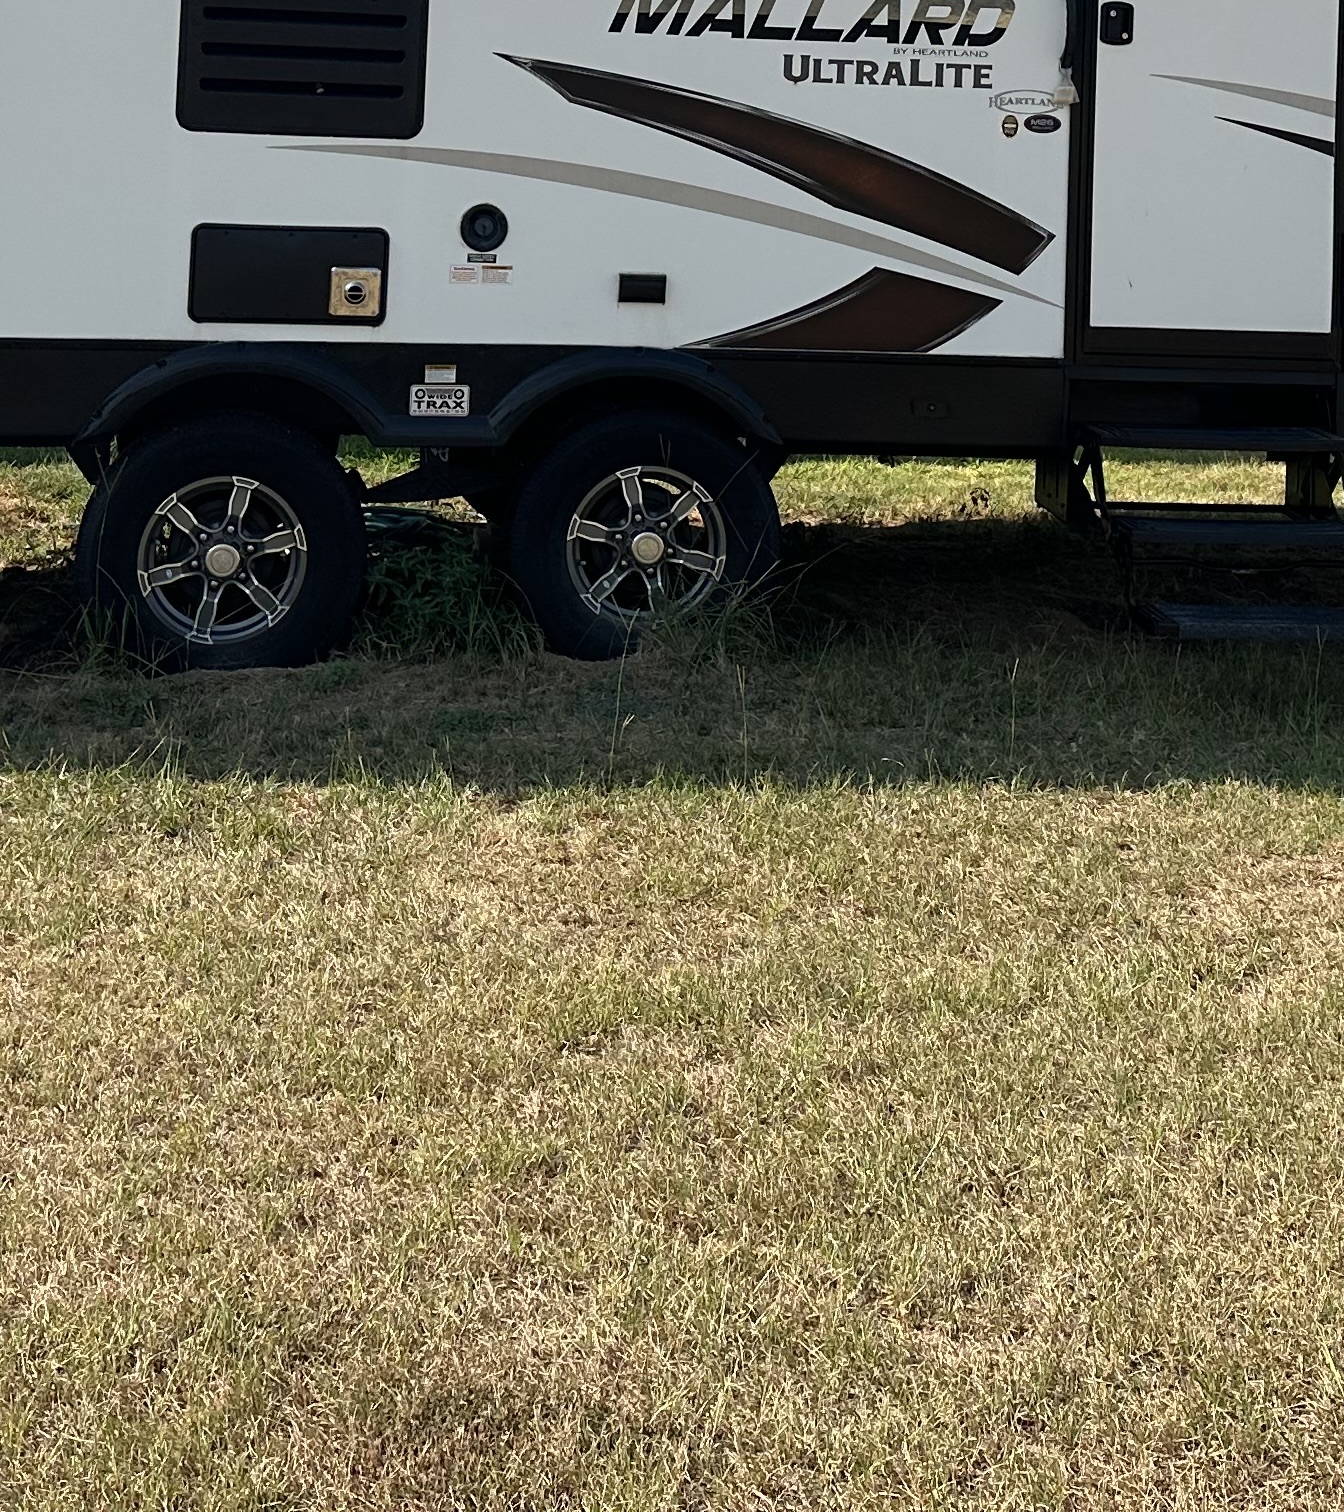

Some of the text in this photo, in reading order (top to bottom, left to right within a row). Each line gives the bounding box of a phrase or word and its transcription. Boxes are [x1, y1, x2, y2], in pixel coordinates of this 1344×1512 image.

[893, 47, 989, 58] BY HEARTLAND
[783, 54, 993, 89] ULTRALITE
[413, 399, 466, 409] TRAX
